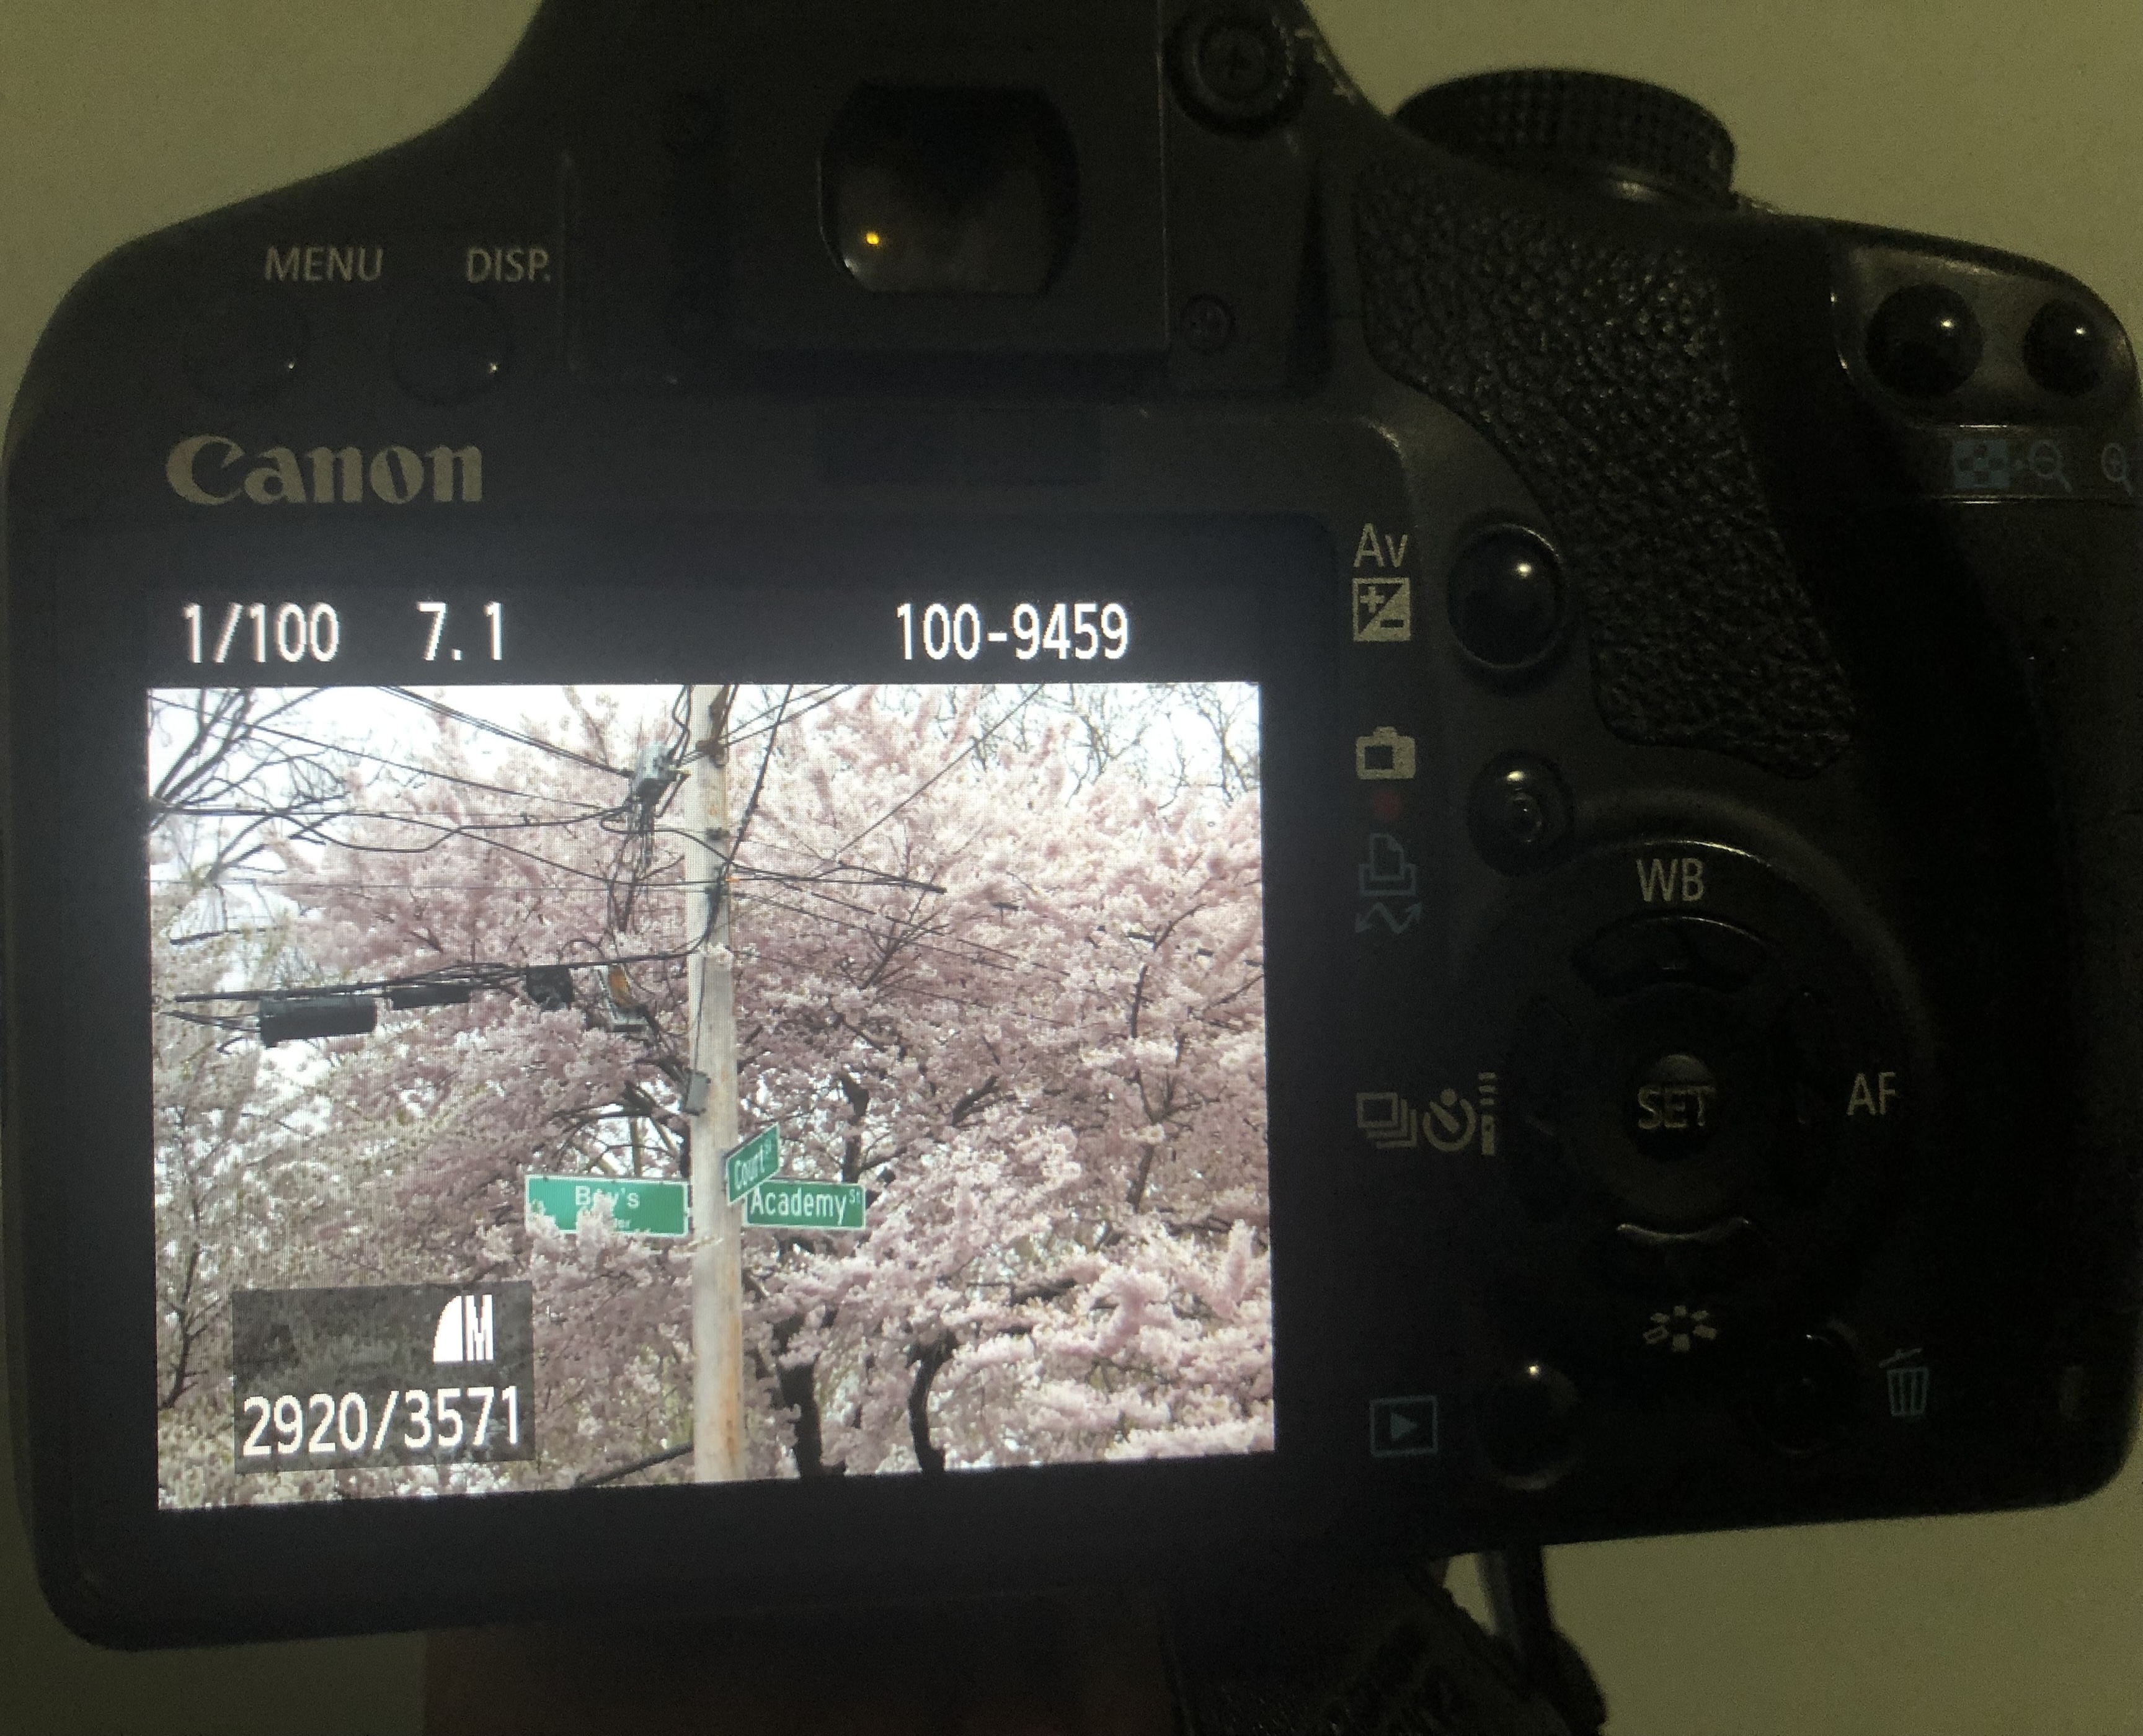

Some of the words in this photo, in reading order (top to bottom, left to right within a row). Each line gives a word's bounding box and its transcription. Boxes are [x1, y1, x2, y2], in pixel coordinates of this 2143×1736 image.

[264, 246, 383, 281] MENU
[466, 247, 552, 283] DISP.
[166, 434, 483, 505] Canon
[1353, 523, 1408, 569] Av
[184, 602, 341, 663] 1/100
[416, 601, 502, 662] 7.1
[897, 603, 1130, 660] 100-9459
[1636, 857, 1706, 902] WB
[1637, 1085, 1716, 1130] SET
[1846, 1071, 1897, 1116] AF
[734, 1144, 765, 1190] Court
[750, 1186, 847, 1226] Academy
[243, 1385, 519, 1456] 2920/3571
